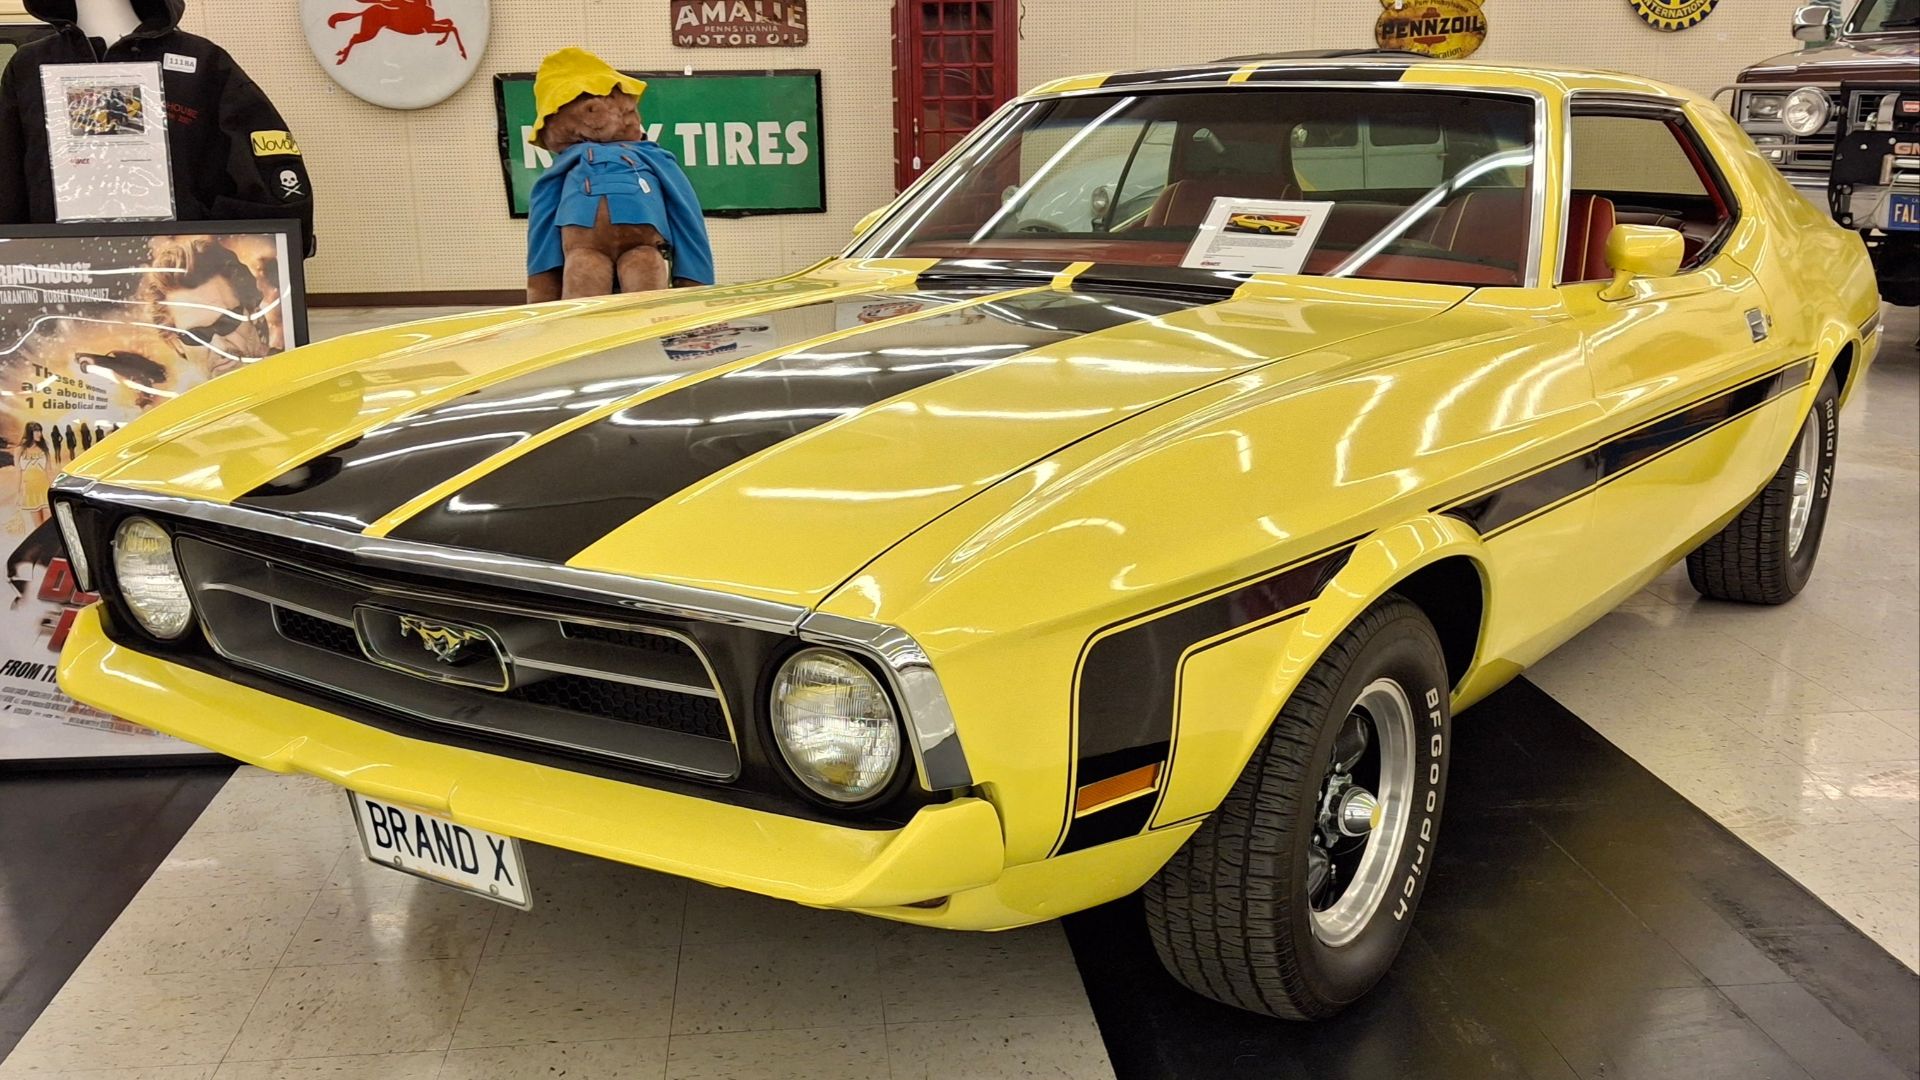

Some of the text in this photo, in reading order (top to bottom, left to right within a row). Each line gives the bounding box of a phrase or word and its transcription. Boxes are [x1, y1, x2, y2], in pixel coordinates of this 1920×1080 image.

[704, 25, 778, 33] PENNSYLVANIA
[1382, 16, 1485, 39] PENNZOIL
[679, 34, 757, 45] MOTOR
[675, 121, 808, 166] TIRES
[21, 382, 51, 394] ae
[56, 388, 86, 399] about
[25, 397, 34, 409] 1
[42, 399, 93, 410] diabolical
[1825, 399, 1835, 457] Radial
[0, 659, 44, 680] FROM
[1393, 687, 1443, 921] BFGoodrich
[365, 800, 515, 887] BRAND X
